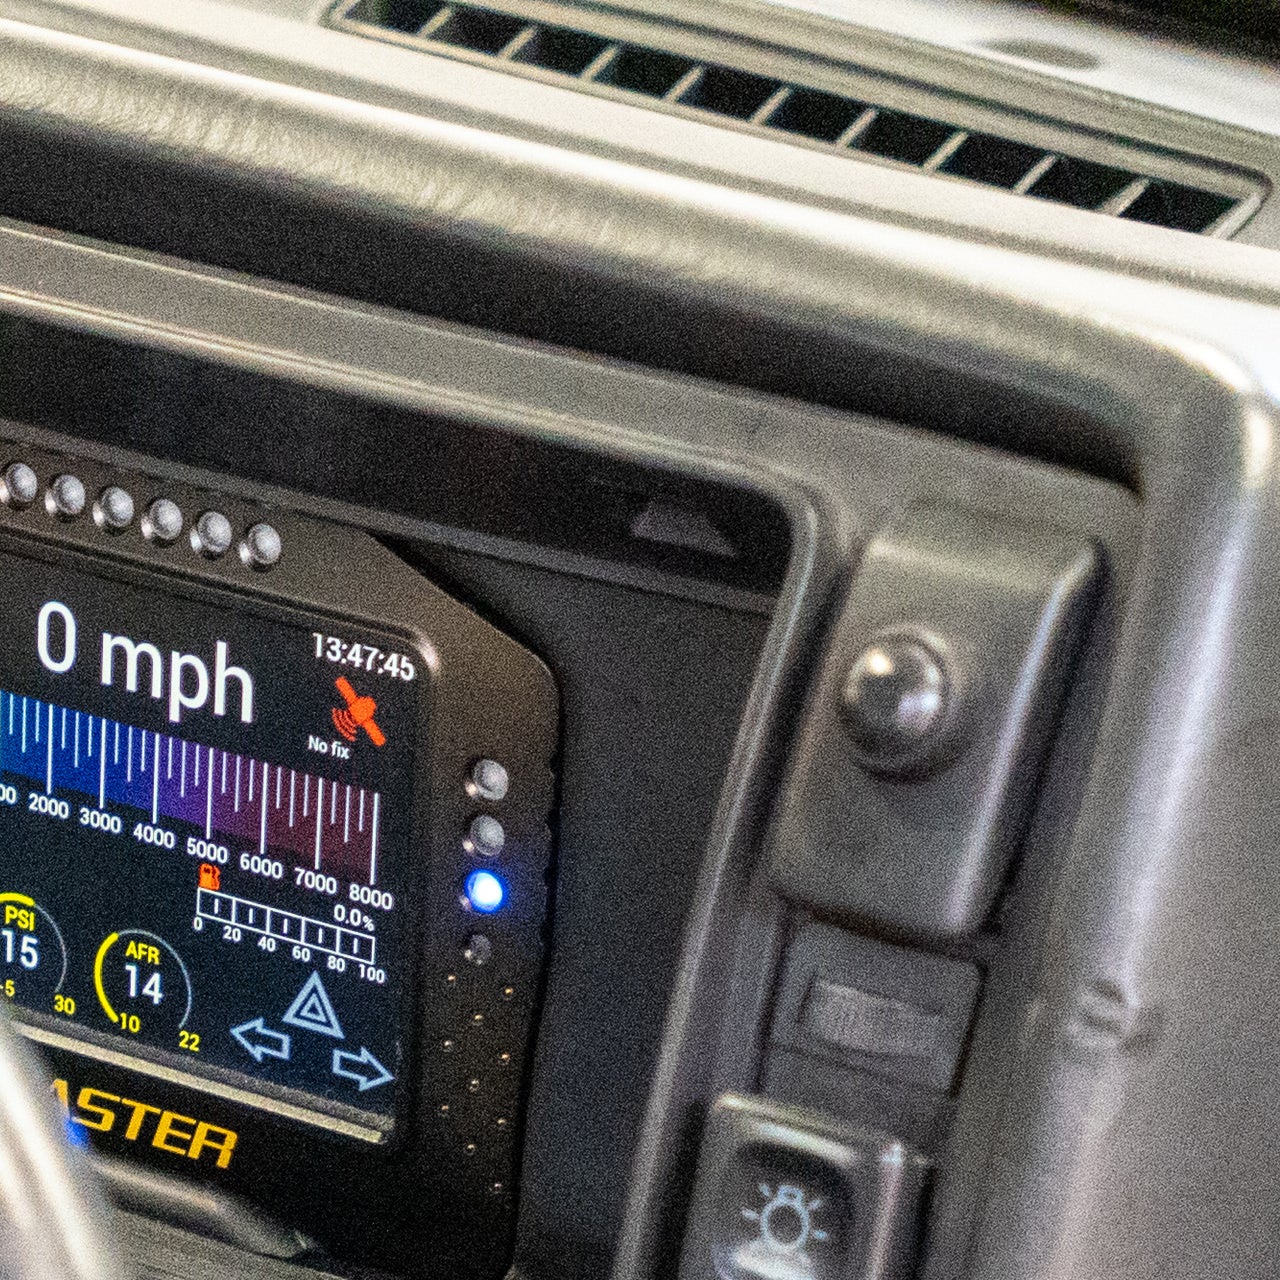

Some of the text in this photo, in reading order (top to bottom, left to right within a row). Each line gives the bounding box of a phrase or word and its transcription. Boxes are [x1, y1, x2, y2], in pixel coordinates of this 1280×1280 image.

[36, 600, 254, 724] 0 mph
[312, 632, 415, 681] 13:47:45
[307, 735, 350, 760] No fix
[28, 792, 69, 820] 2000
[79, 807, 122, 834] 3000
[133, 822, 175, 849] 4000
[187, 837, 228, 864] 5000
[240, 853, 283, 879] 6000
[294, 867, 337, 895] 7000
[349, 884, 393, 910] 8000
[4, 904, 35, 932] PSI
[334, 904, 375, 932] 0.0%
[1, 928, 39, 969] 15
[126, 940, 160, 965] AFR
[193, 916, 386, 984] 0 20 40 60 80 100
[125, 963, 164, 1005] 14
[54, 995, 76, 1015] 30
[119, 1012, 200, 1052] 10 22
